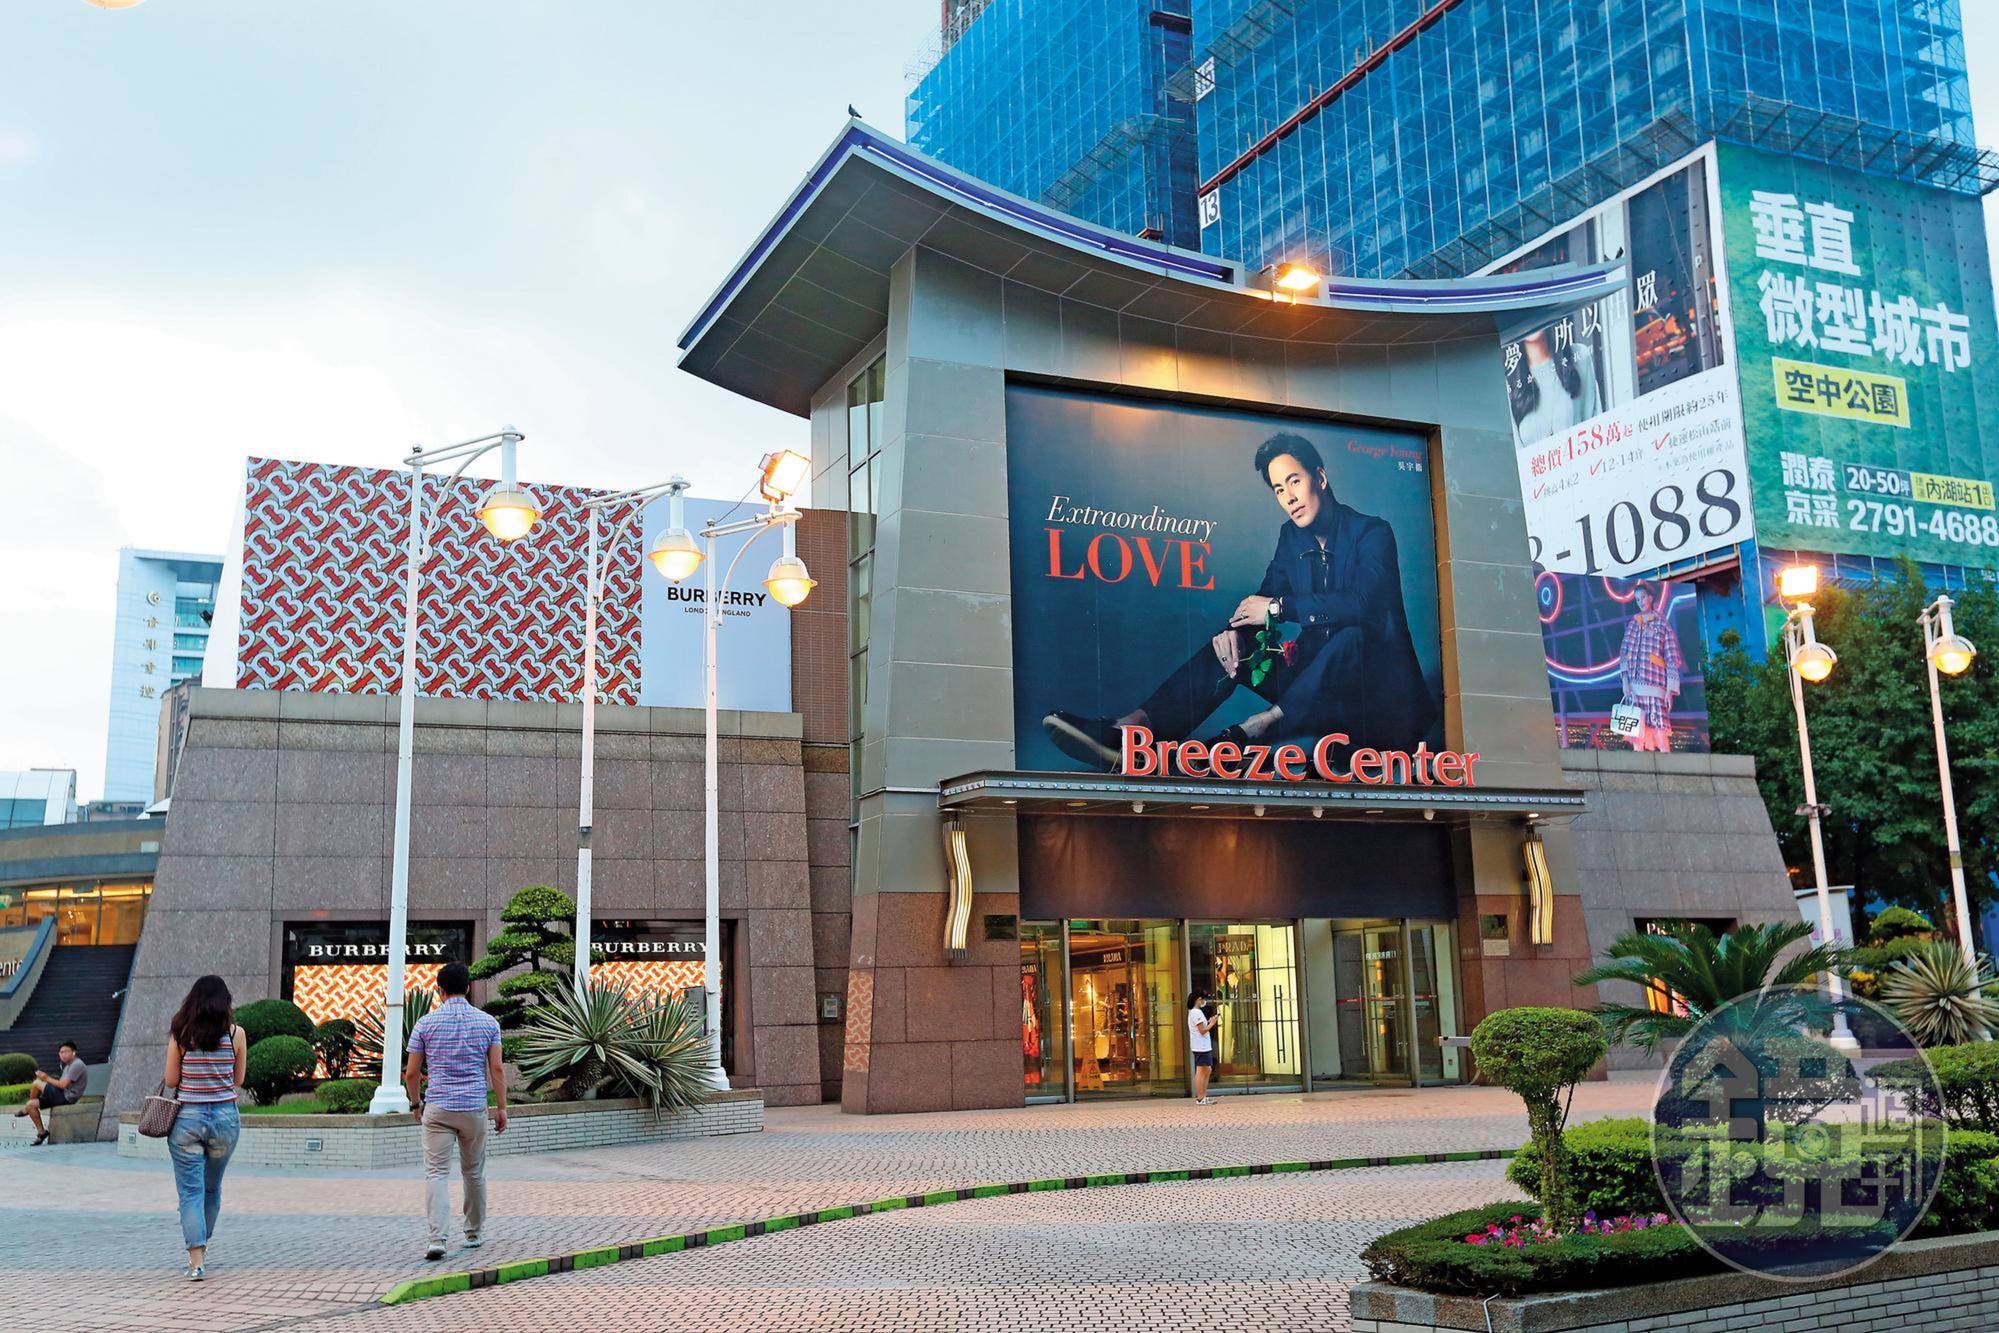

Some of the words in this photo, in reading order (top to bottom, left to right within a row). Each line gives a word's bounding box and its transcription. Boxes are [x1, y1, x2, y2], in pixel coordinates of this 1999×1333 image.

[1201, 191, 1219, 224] 13
[1750, 190, 1861, 276] 垂直
[1757, 269, 1971, 372] 微型城市
[1785, 370, 1899, 417] 空中公園
[1780, 451, 1836, 491] 潤泰
[1045, 496, 1217, 543] Extraordinary
[1847, 500, 1999, 547] 2791-4688
[1044, 528, 1215, 590] LOVE
[667, 587, 767, 606] BURERRY
[717, 609, 751, 617] NGLAND
[1121, 725, 1307, 780] Breeze
[1313, 733, 1480, 787] Center
